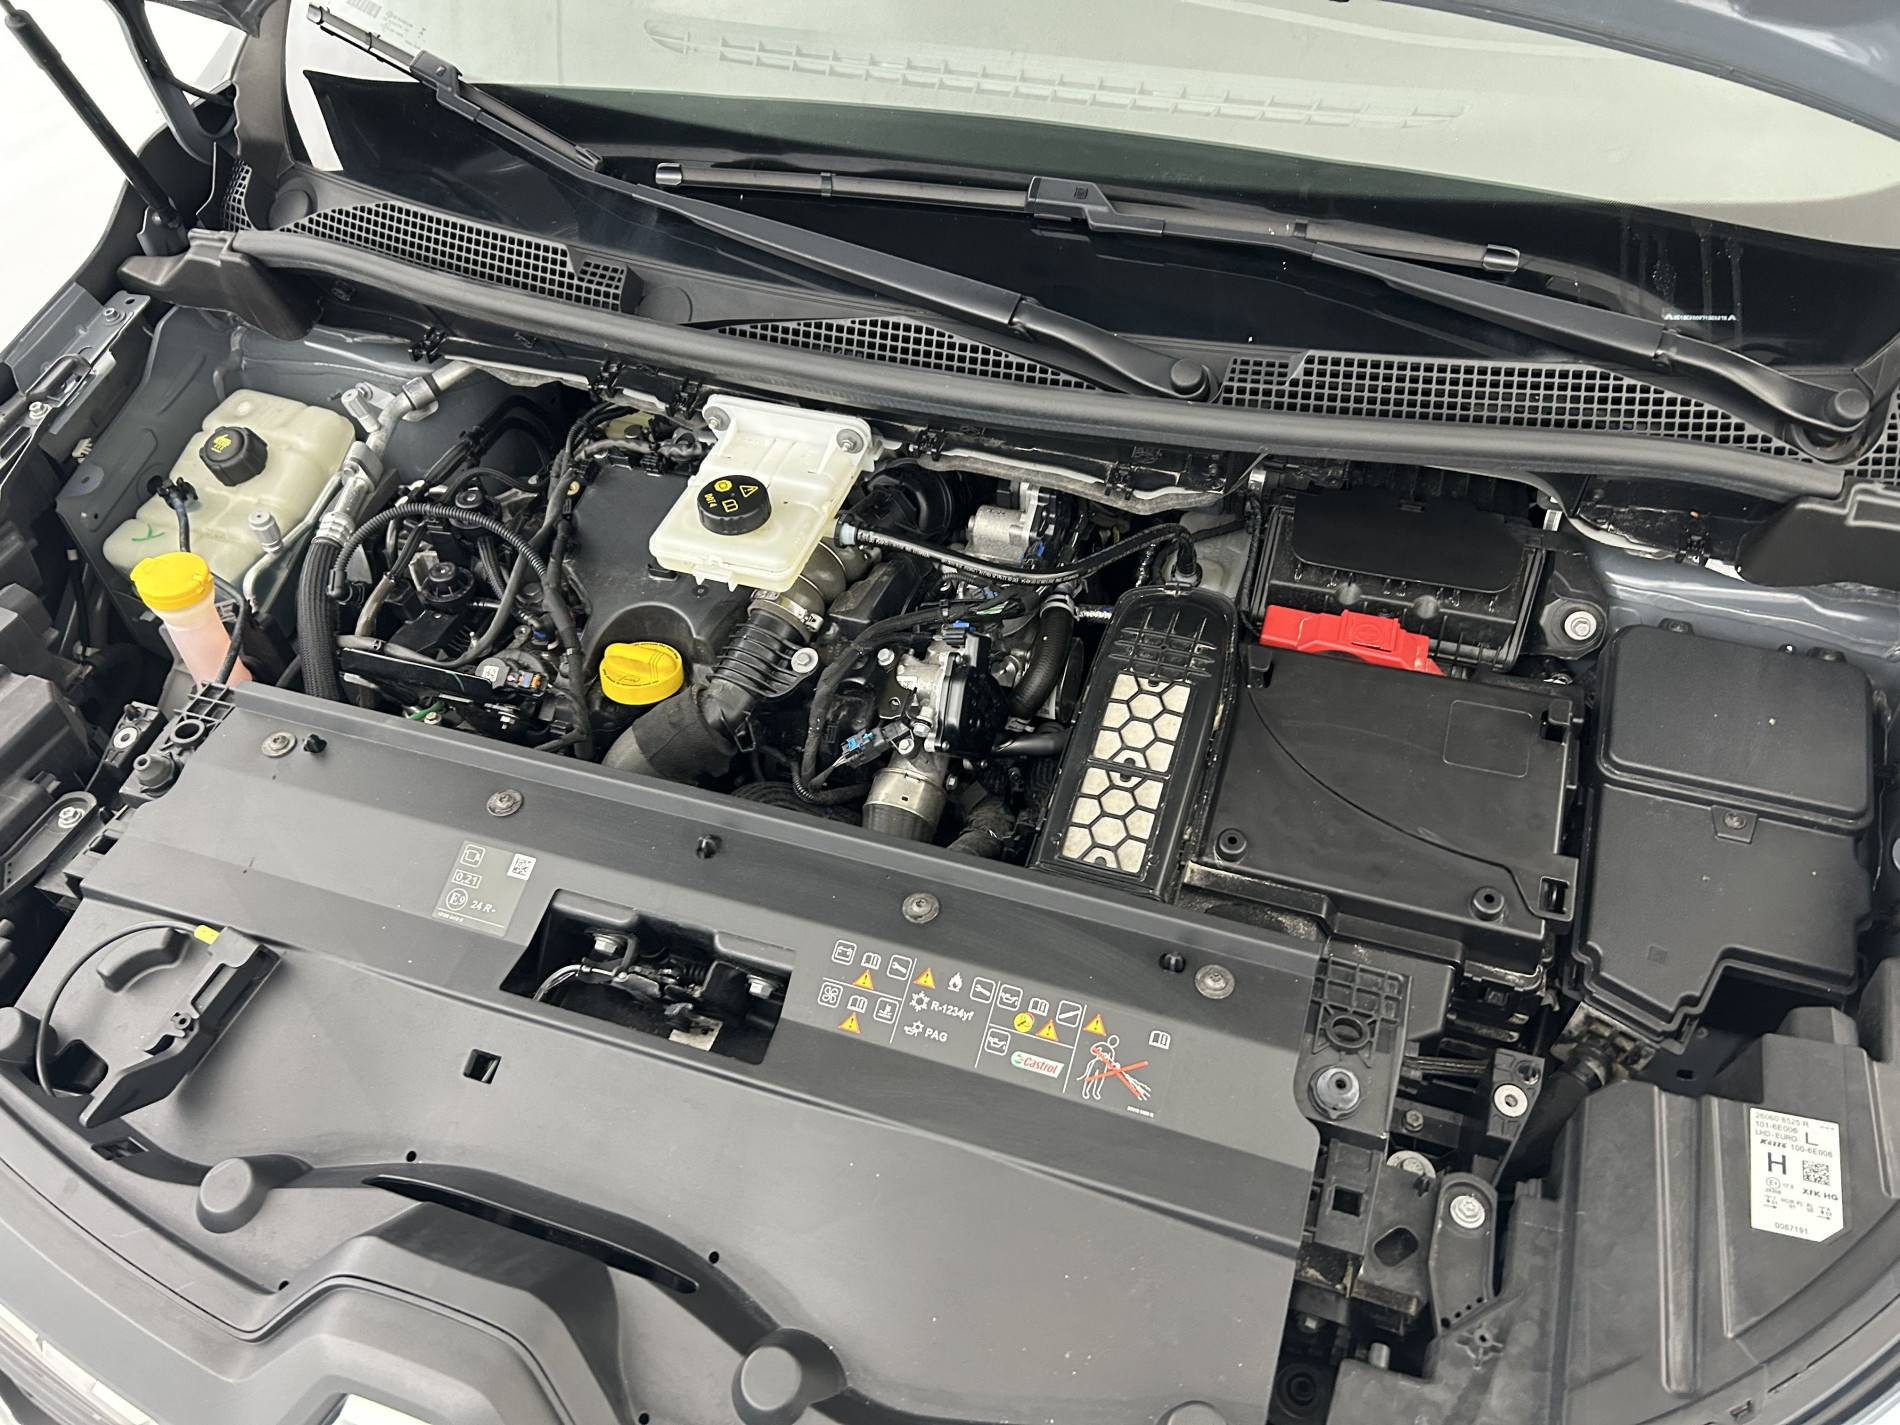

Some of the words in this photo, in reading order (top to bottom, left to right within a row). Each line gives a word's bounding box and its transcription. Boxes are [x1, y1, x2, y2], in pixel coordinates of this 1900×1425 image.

[930, 1001, 975, 1022] R-1234yf
[924, 1027, 948, 1042] PAG
[1023, 1056, 1059, 1075] Castrol
[1805, 1131, 1819, 1147] L
[1767, 1152, 1787, 1176] H
